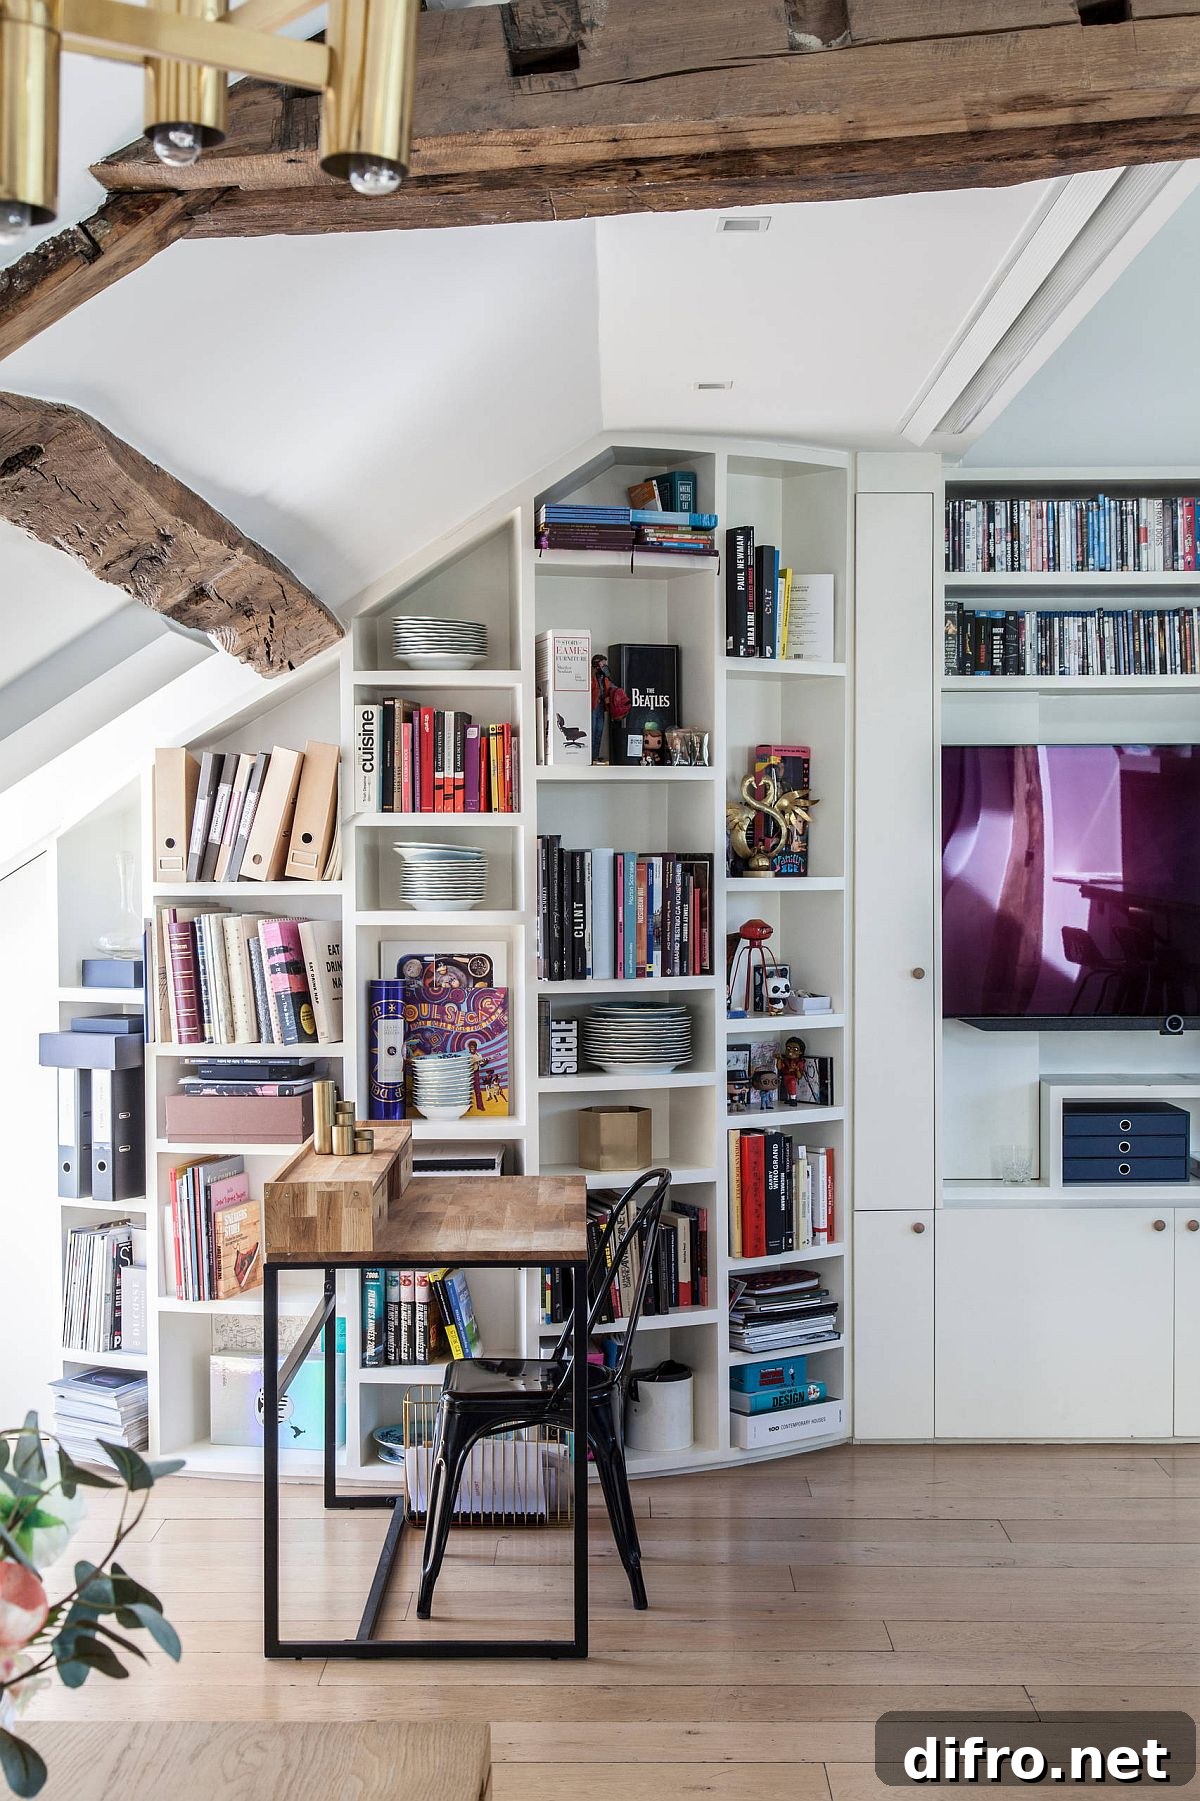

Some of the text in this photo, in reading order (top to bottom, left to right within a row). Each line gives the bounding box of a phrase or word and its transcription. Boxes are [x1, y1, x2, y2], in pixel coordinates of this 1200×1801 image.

[736, 535, 745, 591] PAUL NEWMAN
[556, 647, 587, 655] EAMES
[632, 688, 670, 710] BEATLES
[358, 710, 375, 773] cuisine
[574, 902, 584, 938] CLINT
[327, 945, 340, 956] EAT
[326, 962, 343, 972] DRIN
[332, 978, 343, 988] NA
[404, 1003, 440, 1022] OUL
[551, 1020, 578, 1074] SIECLE
[368, 1289, 376, 1307] FILMS
[368, 1308, 376, 1319] DES
[772, 1392, 805, 1407] DESIGN
[781, 1420, 811, 1430] CONTEMPORARY
